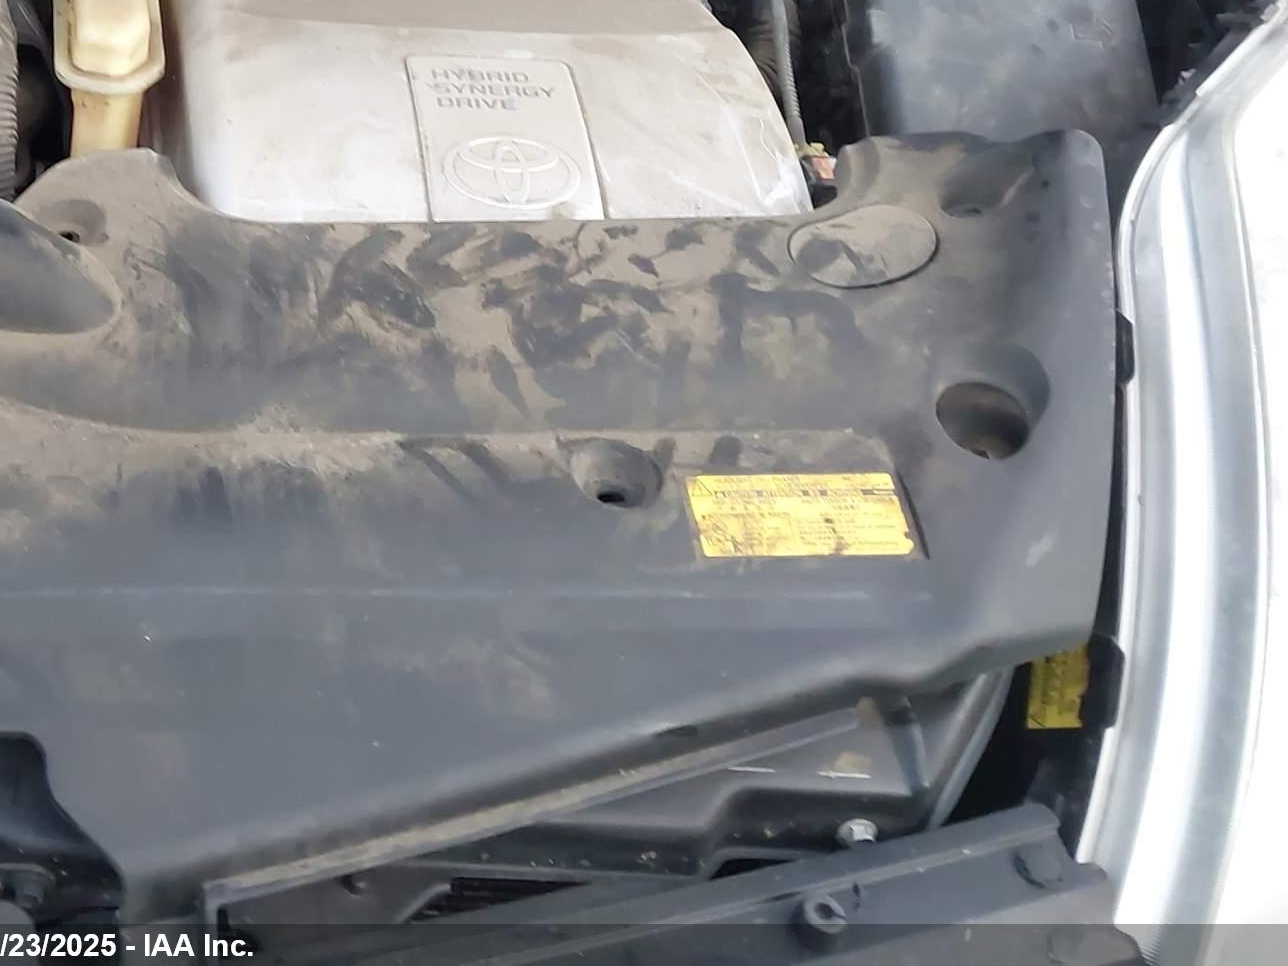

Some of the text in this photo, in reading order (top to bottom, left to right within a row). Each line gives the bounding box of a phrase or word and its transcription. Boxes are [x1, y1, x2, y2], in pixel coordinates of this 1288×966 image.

[431, 69, 530, 82] HYBRID
[432, 83, 556, 97] SYNERGY
[436, 98, 517, 111] DRIVE
